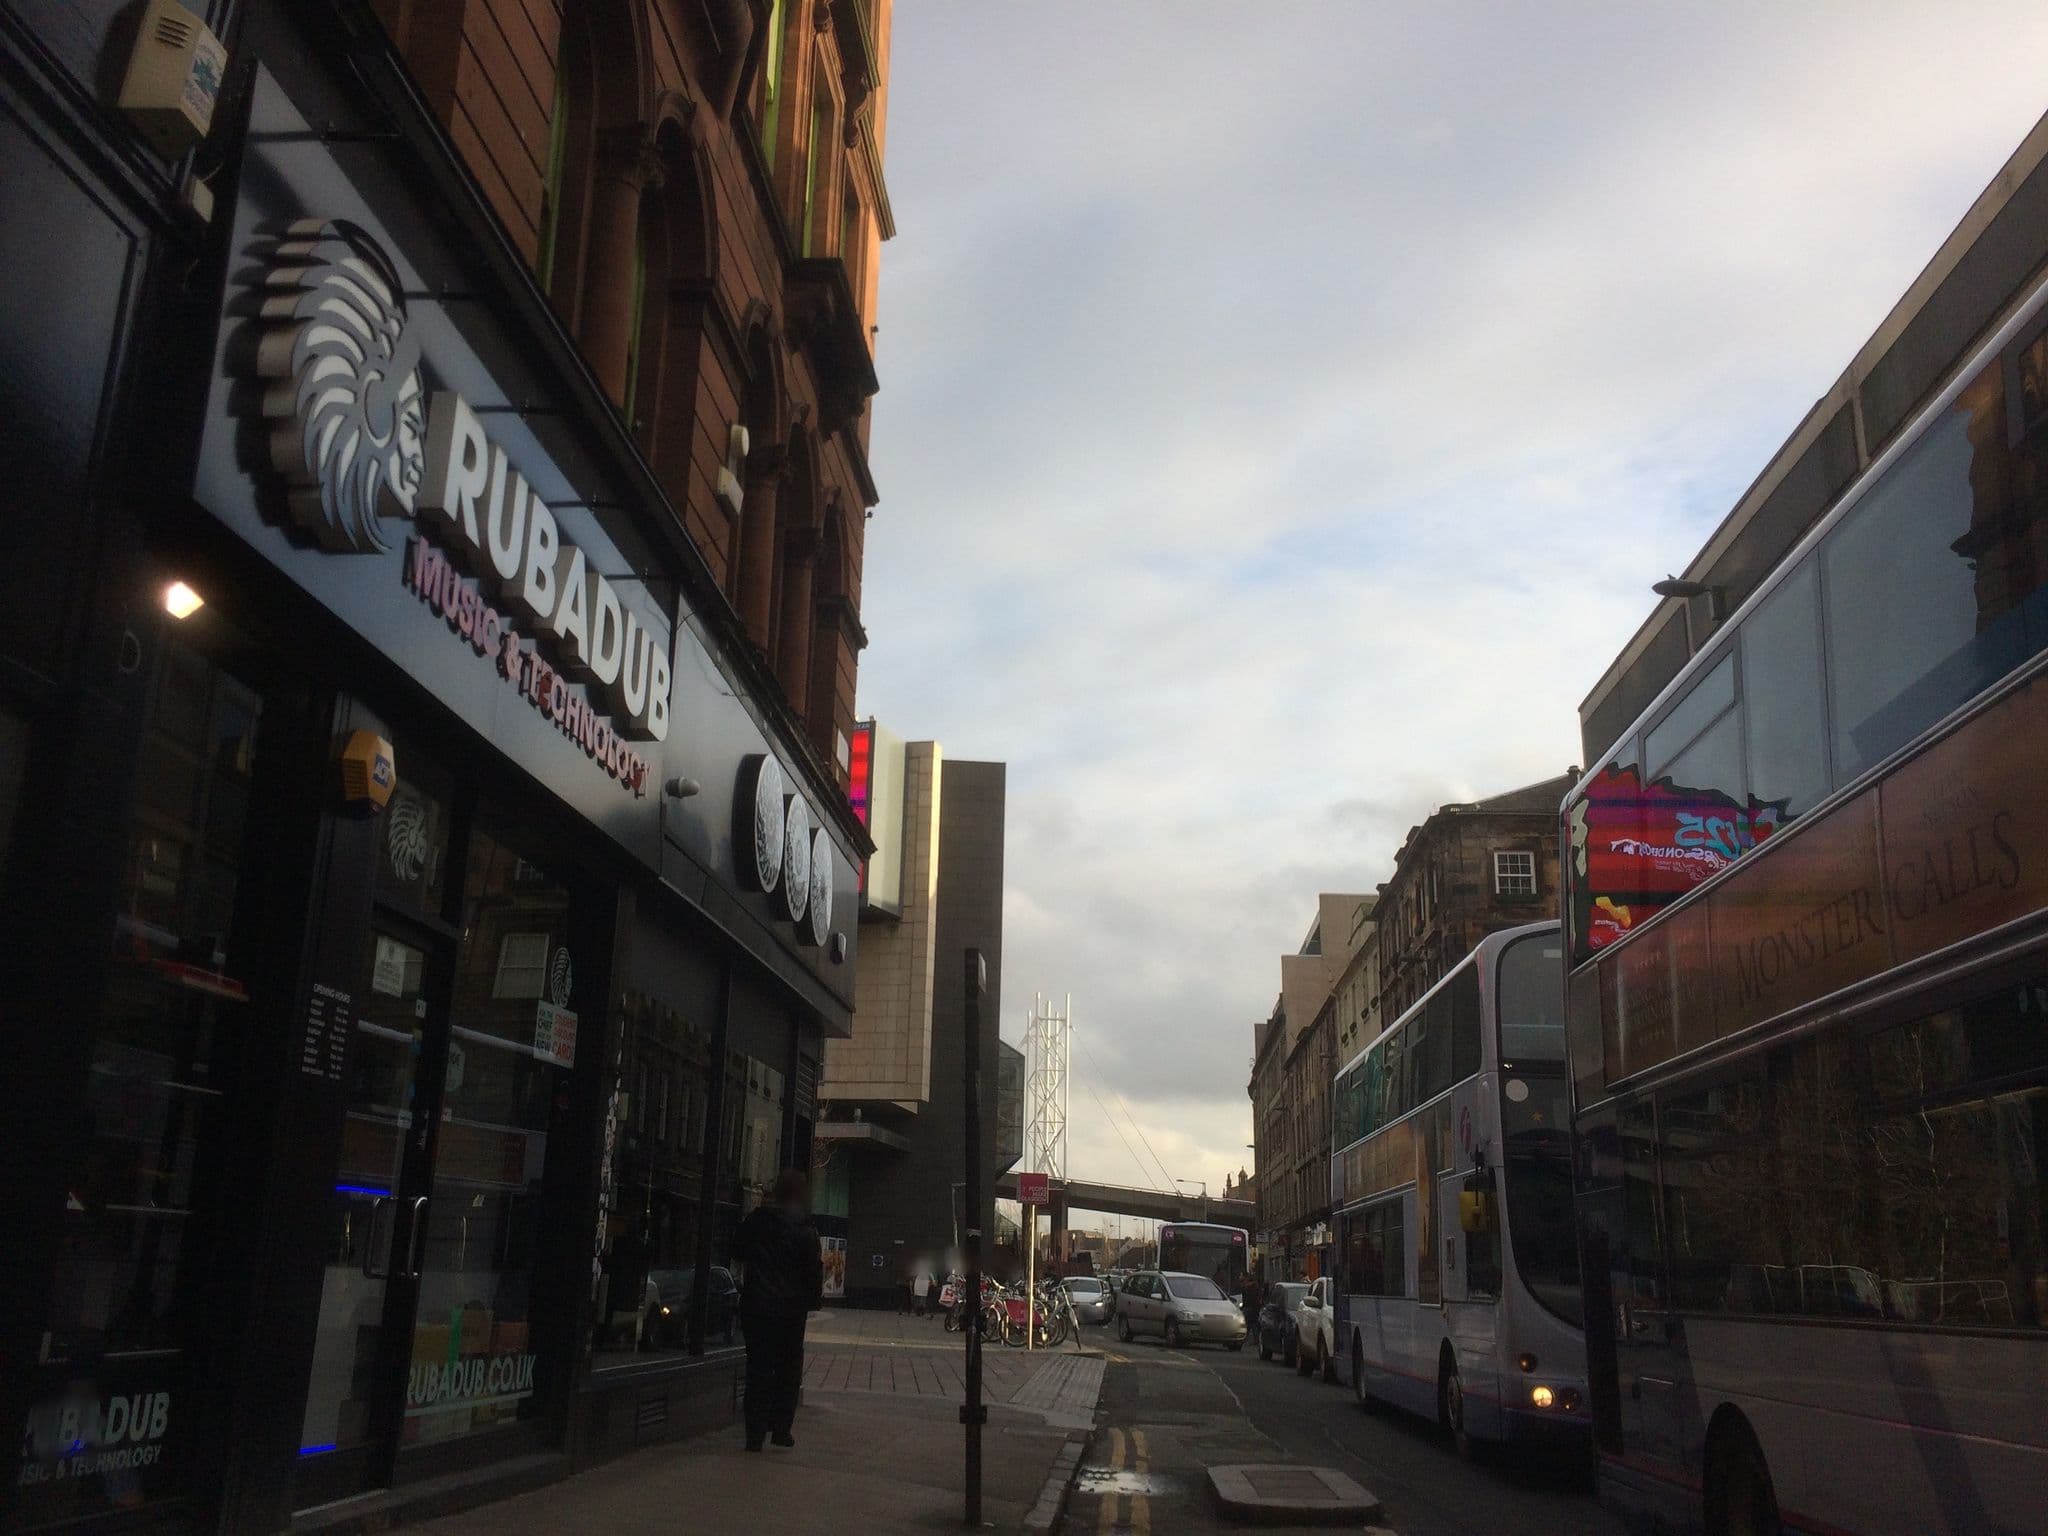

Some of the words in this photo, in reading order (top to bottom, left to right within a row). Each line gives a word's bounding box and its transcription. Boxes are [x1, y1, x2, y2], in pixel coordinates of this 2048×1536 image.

[411, 534, 502, 659] MUSIC
[505, 630, 524, 682] &
[525, 647, 654, 799] TECHNOLOGY
[440, 391, 671, 742] RUBADUB
[1734, 886, 1885, 1006] MONSTER
[1894, 809, 2020, 921] CALLS
